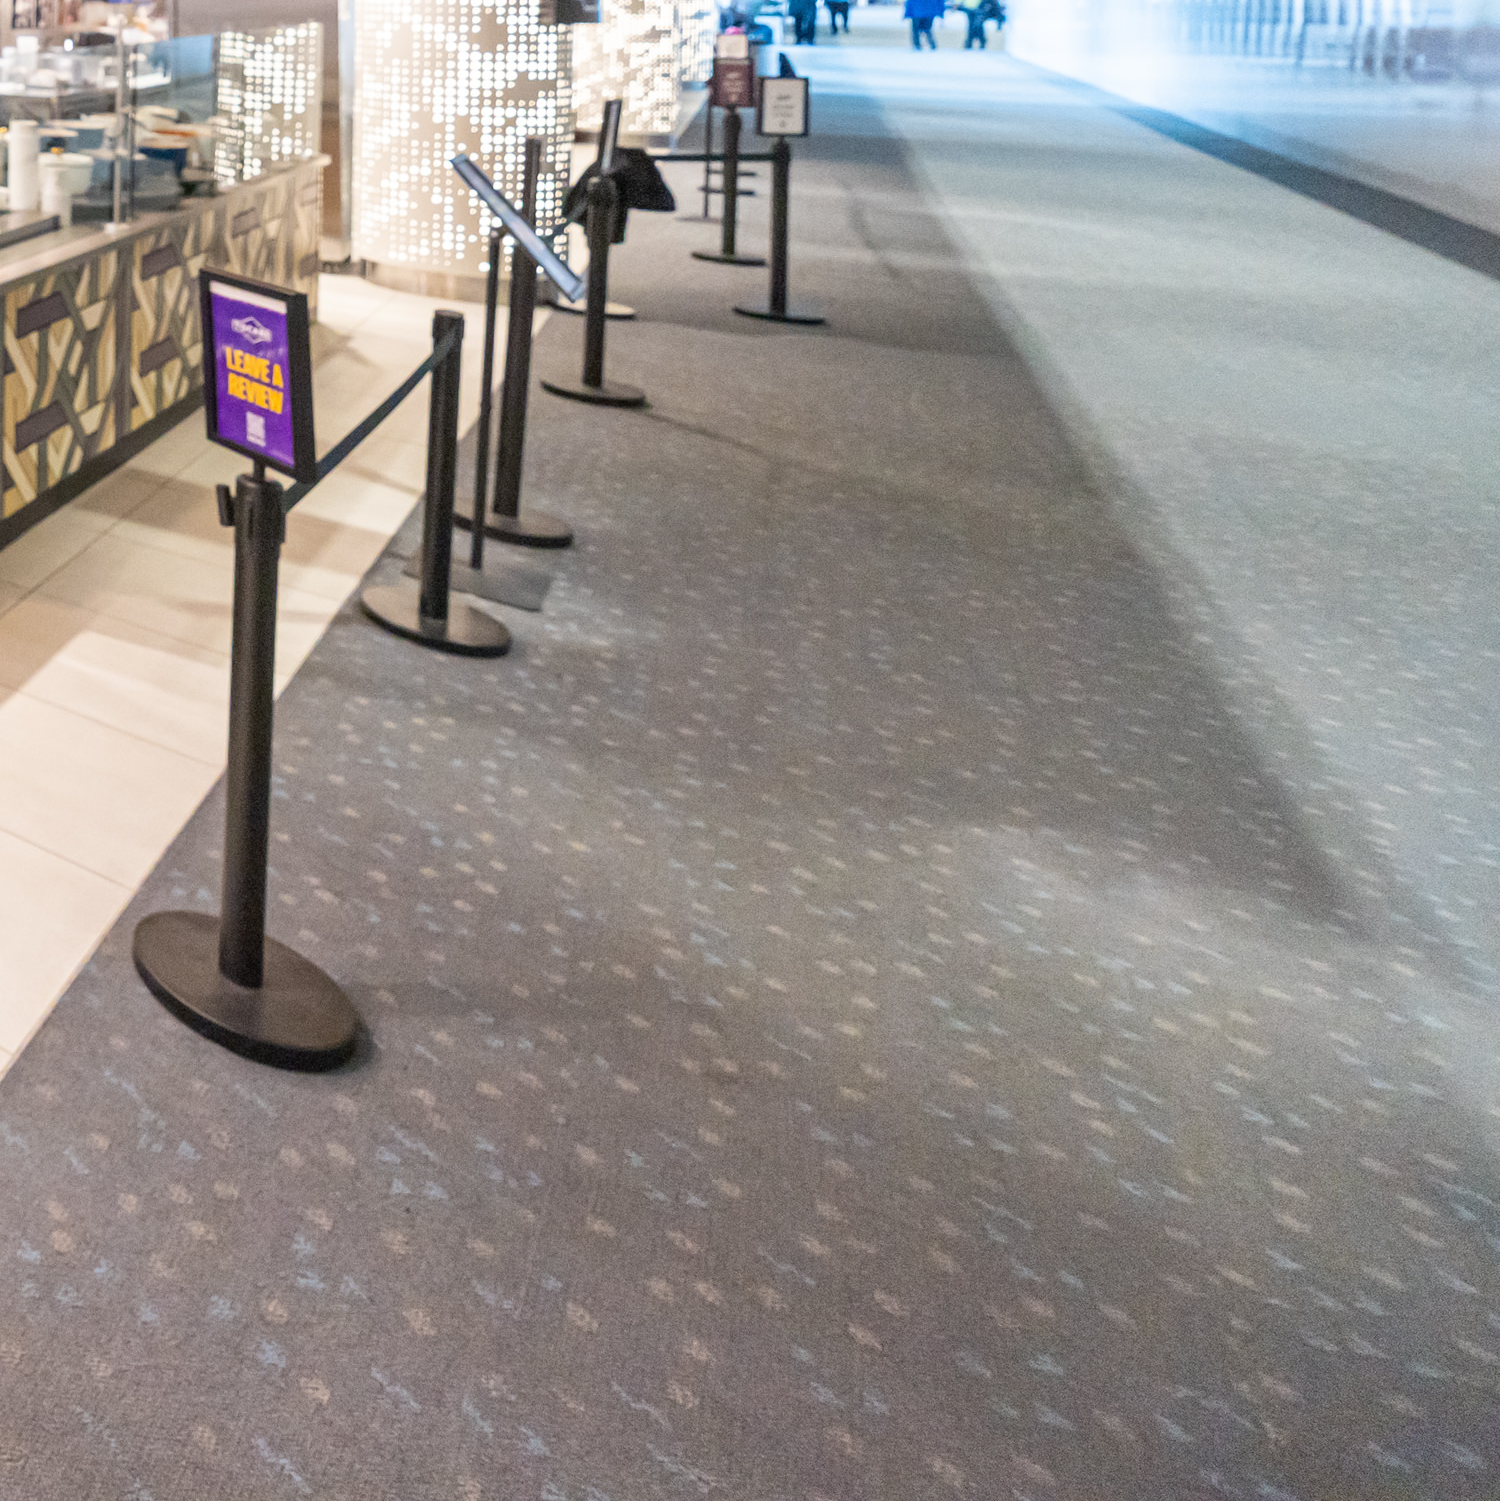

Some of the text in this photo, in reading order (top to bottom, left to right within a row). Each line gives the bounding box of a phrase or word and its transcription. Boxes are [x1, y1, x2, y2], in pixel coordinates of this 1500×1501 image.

[225, 346, 284, 388] LEAVE A
[228, 372, 284, 414] REVIEW
